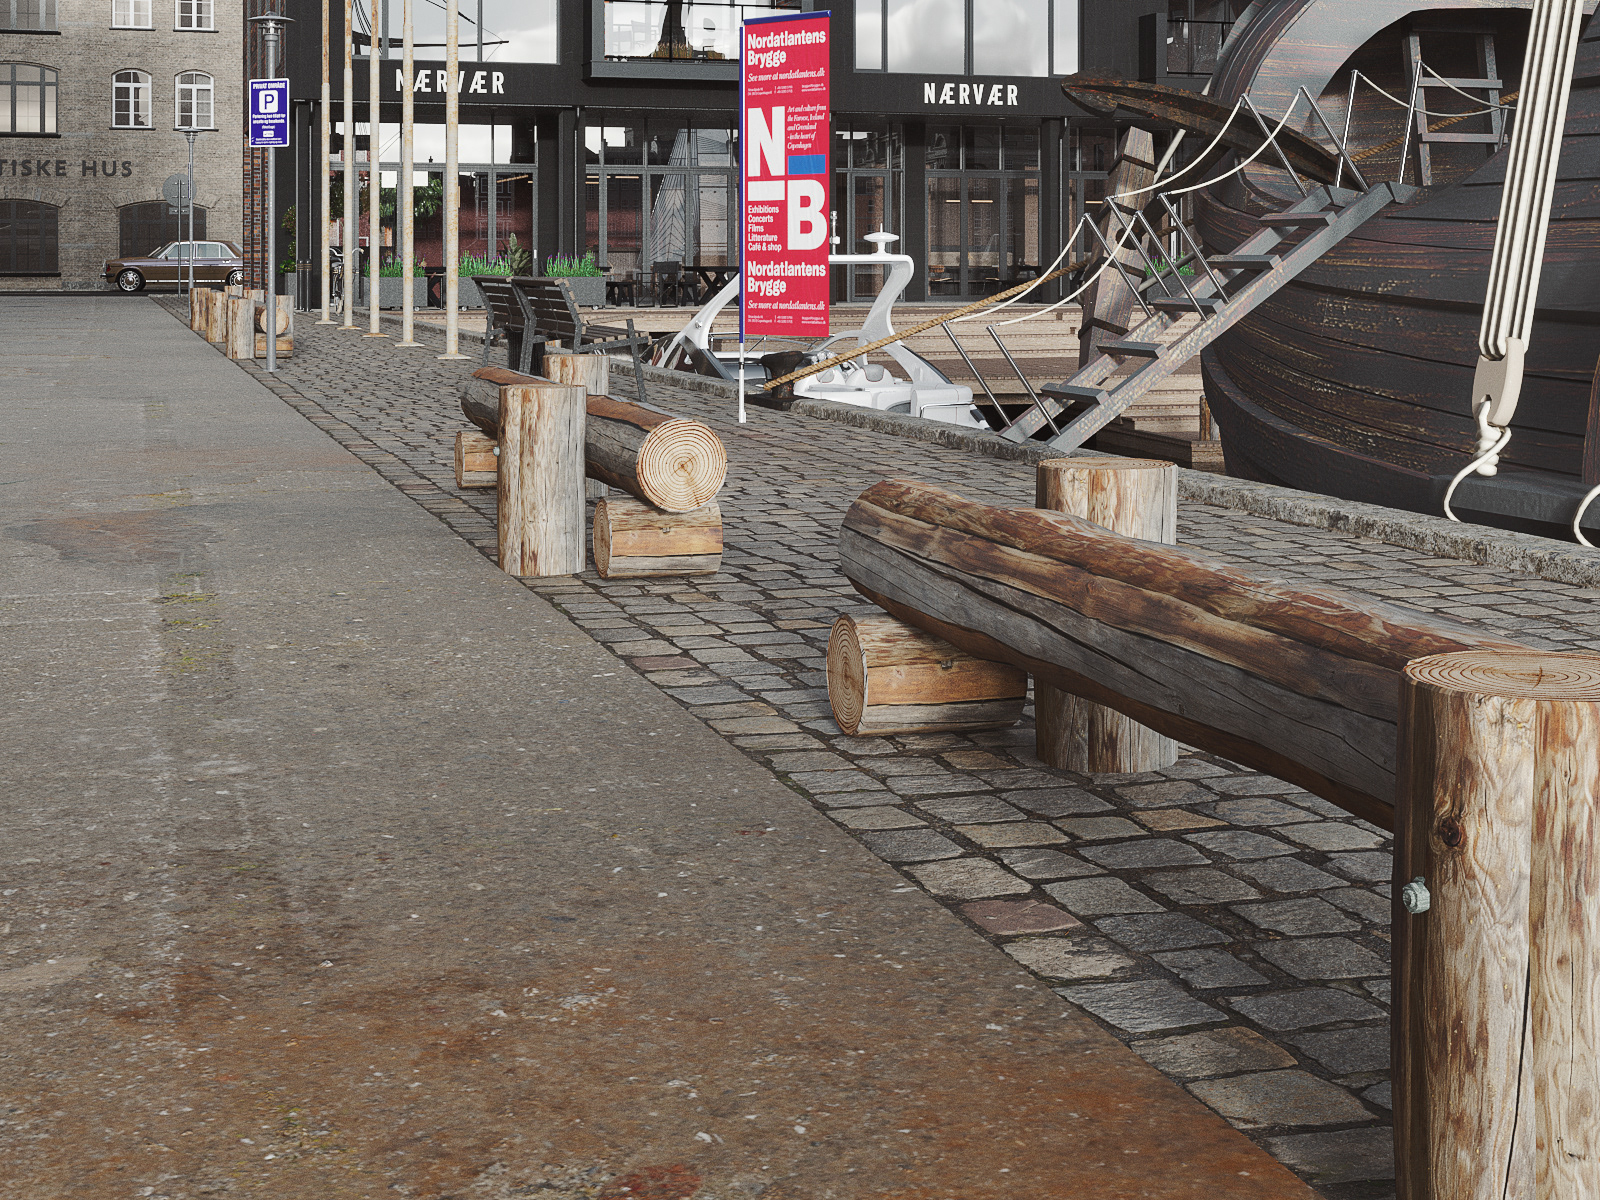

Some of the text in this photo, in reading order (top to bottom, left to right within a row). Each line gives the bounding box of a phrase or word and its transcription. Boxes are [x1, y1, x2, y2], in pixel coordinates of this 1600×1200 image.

[748, 30, 826, 49] Nordatlantens
[748, 50, 787, 68] Brygge
[748, 73, 758, 82] See
[264, 94, 274, 110] P
[924, 82, 1018, 106] NÆRVÆR
[748, 106, 785, 177] N
[82, 160, 132, 178] HUS
[748, 205, 780, 213] Exhibitions
[787, 179, 827, 250] B
[748, 214, 774, 223] Concerts
[748, 224, 764, 232] Films
[748, 242, 782, 253] Café & shop
[748, 261, 826, 276] Nordatlantens
[748, 277, 787, 296] Brygge
[748, 300, 758, 309] See
